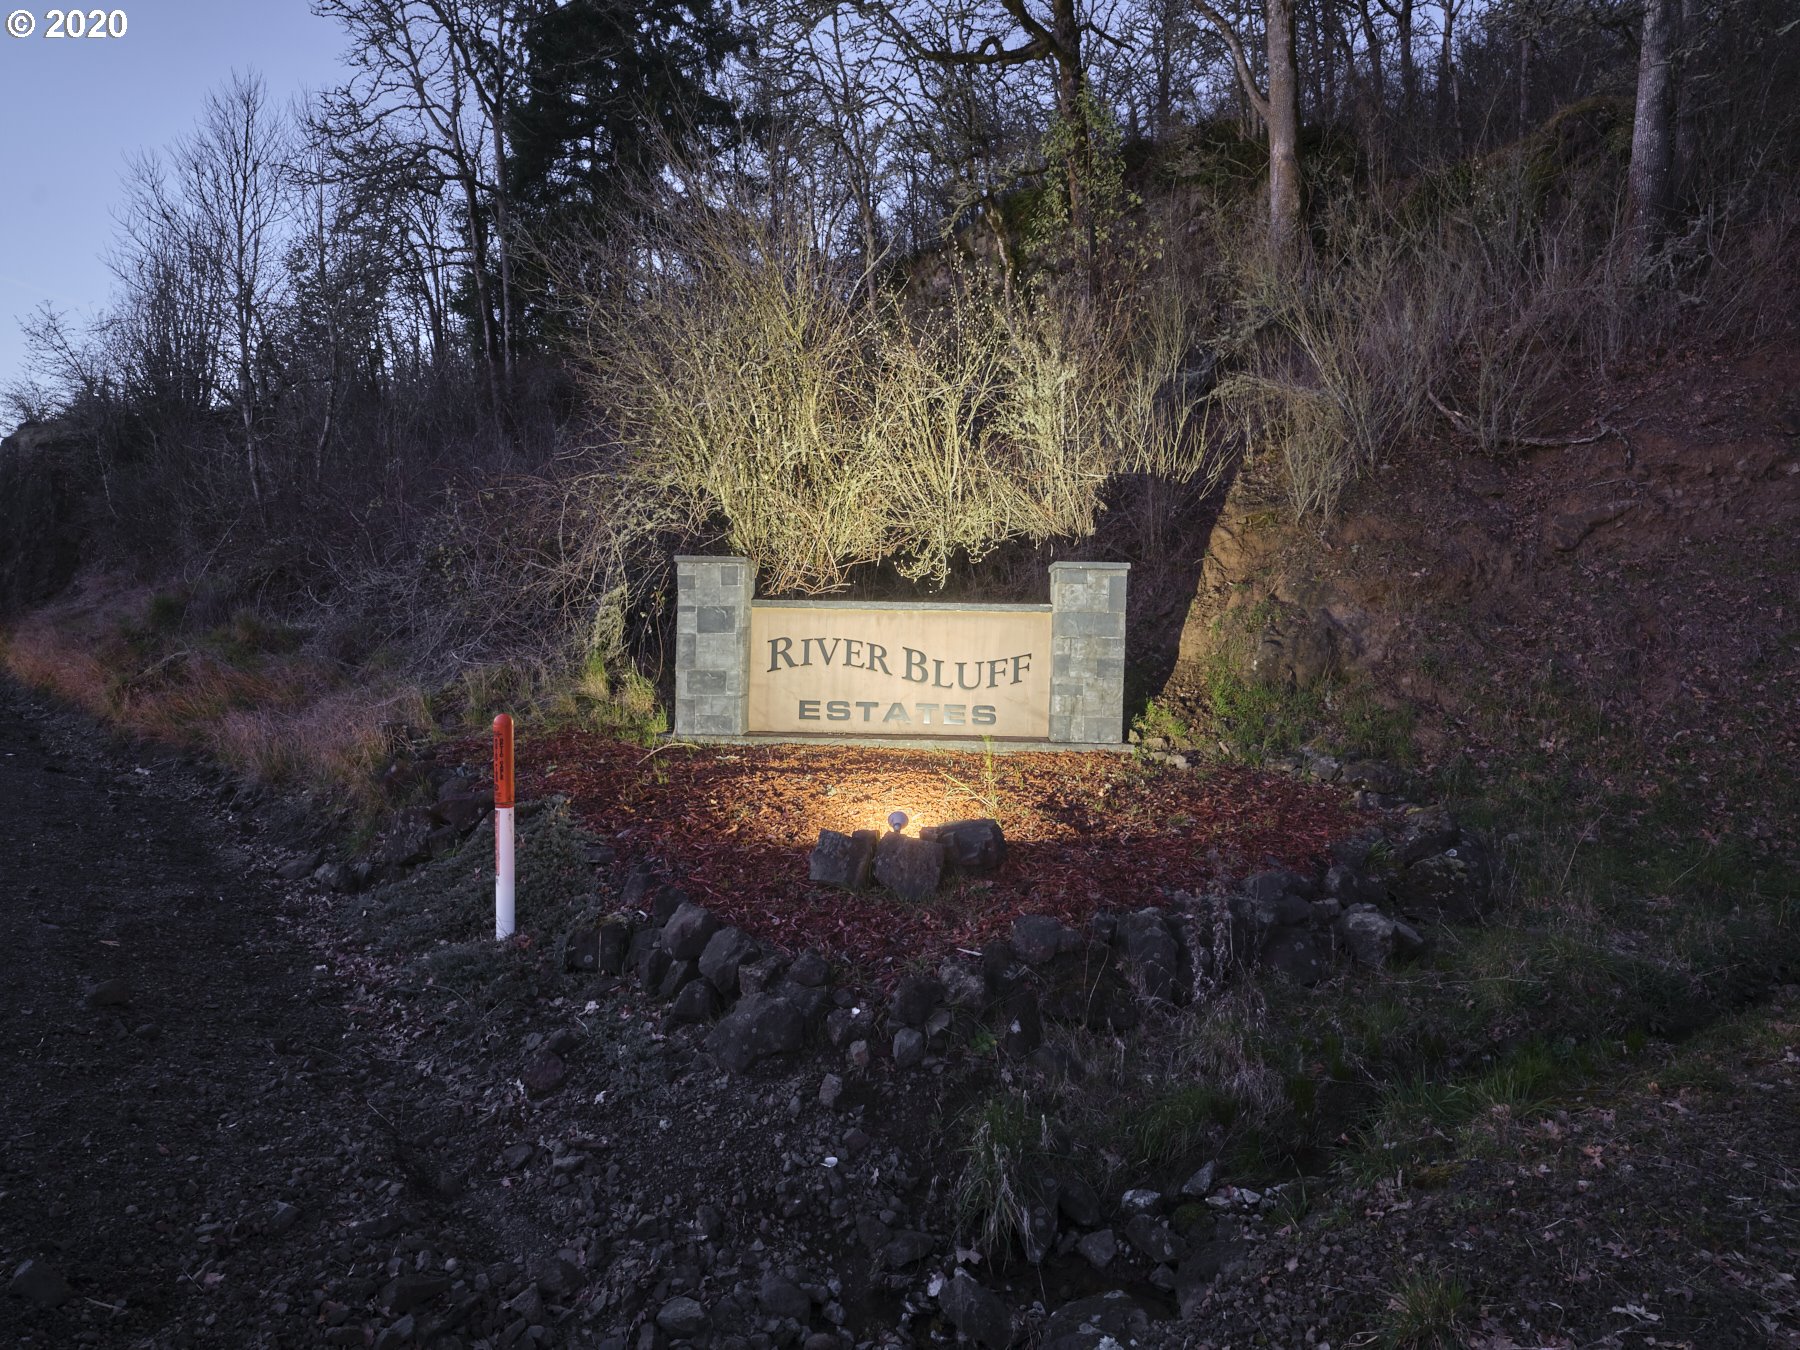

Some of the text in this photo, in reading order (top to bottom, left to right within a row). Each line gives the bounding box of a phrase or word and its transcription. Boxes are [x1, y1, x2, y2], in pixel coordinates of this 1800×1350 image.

[767, 637, 1032, 690] RIVER BLUFF
[799, 700, 997, 725] ESTATES
